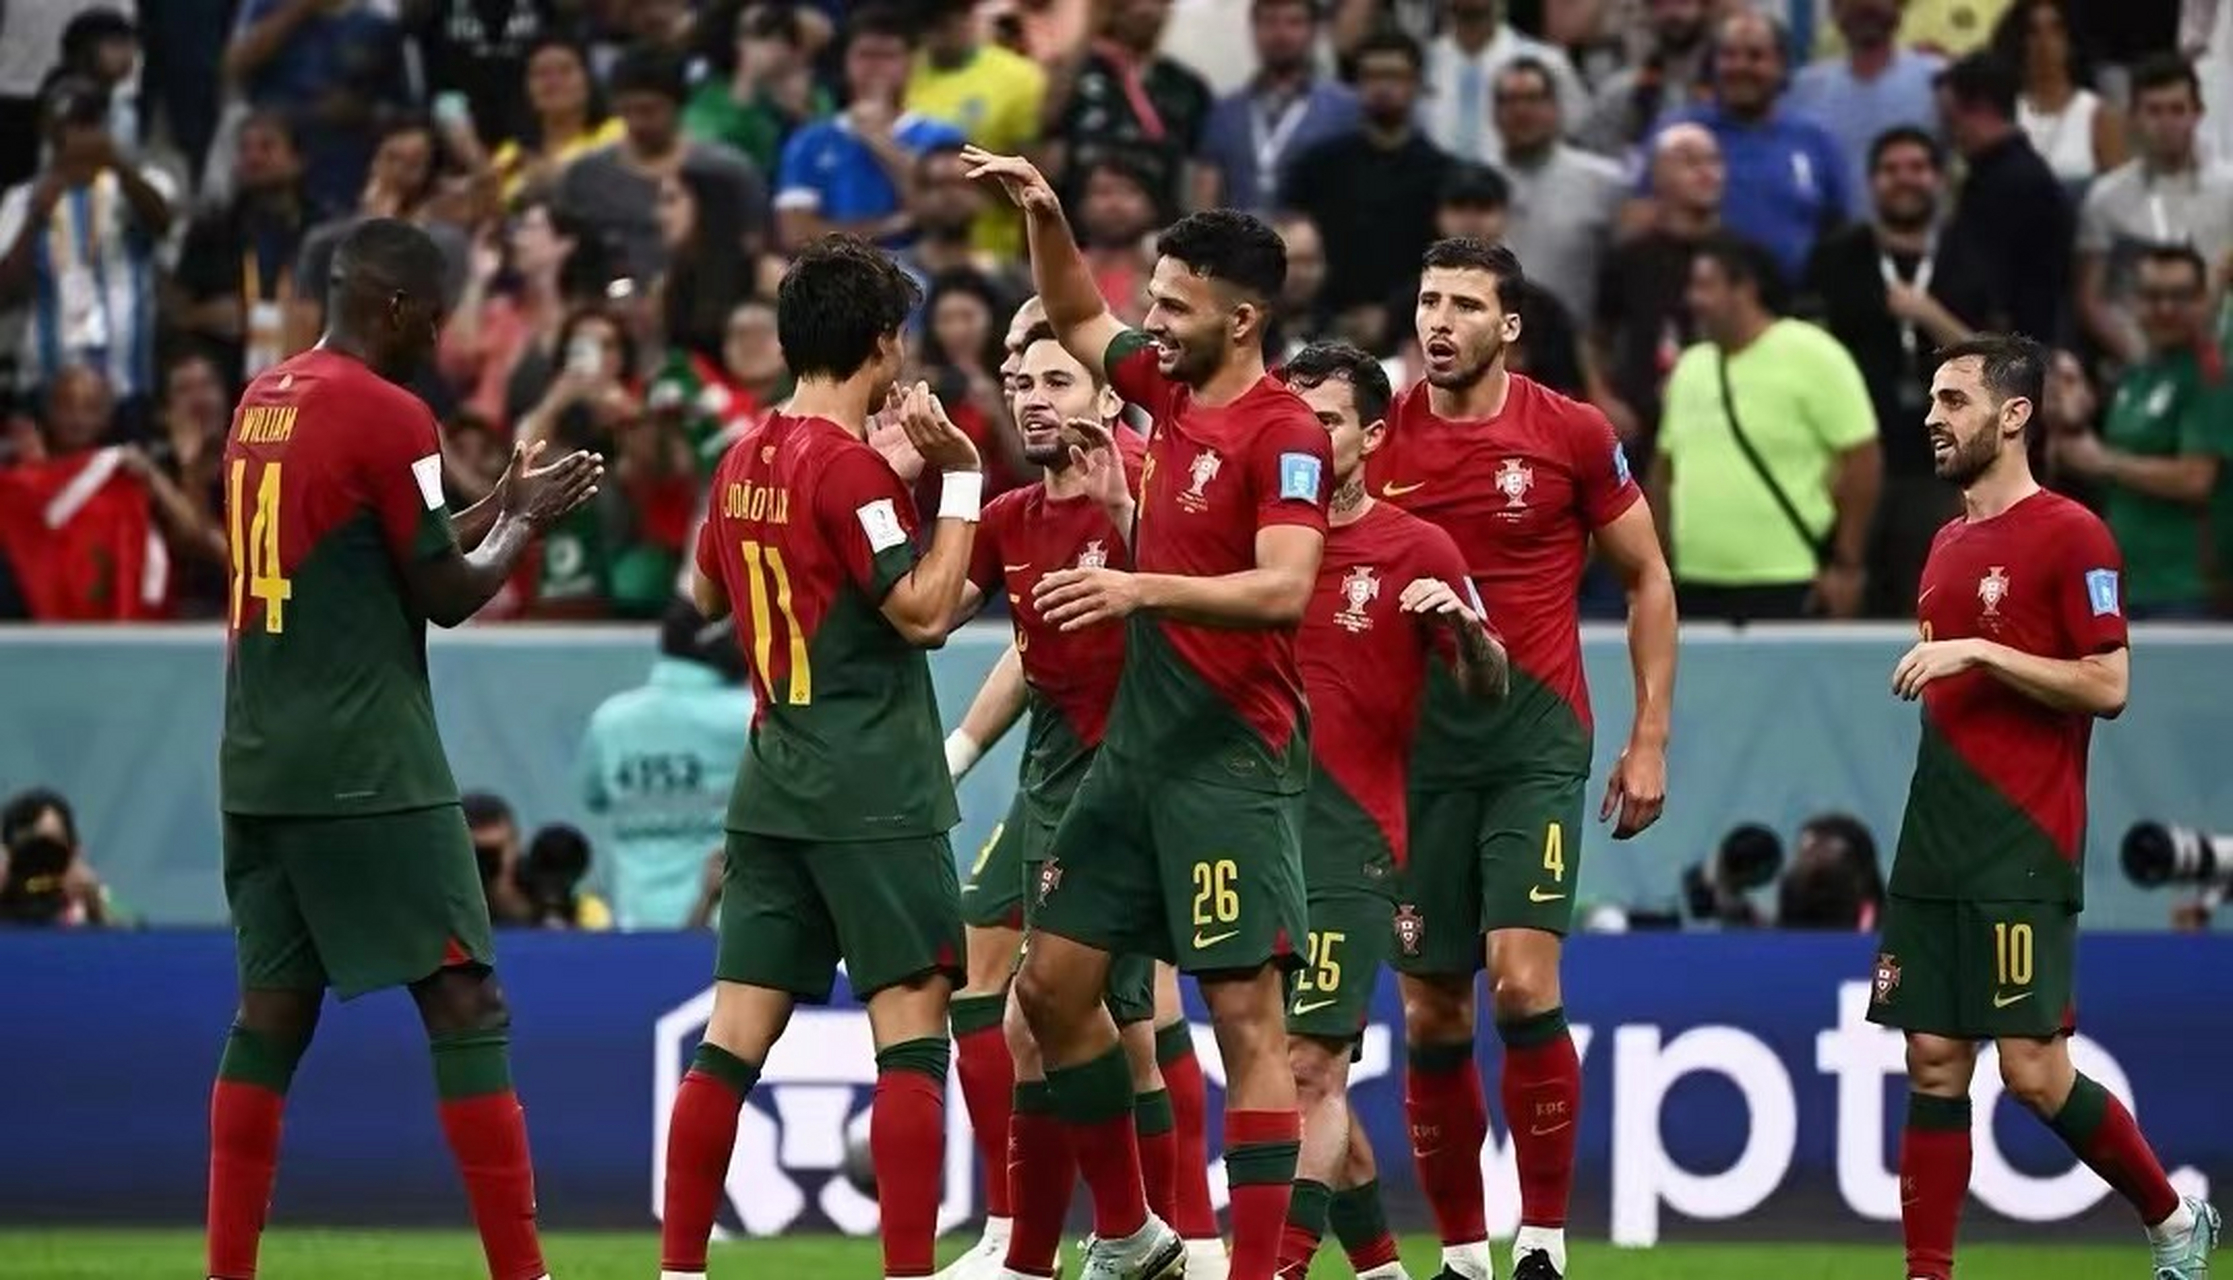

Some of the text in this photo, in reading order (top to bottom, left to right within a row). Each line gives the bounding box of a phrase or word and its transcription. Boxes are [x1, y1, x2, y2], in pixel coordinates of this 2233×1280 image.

[238, 406, 299, 443] WILLIAM
[231, 458, 292, 633] 14
[741, 541, 811, 705] 11
[1543, 822, 1565, 882] 4
[1193, 859, 1240, 925] 26
[1297, 931, 1345, 992] 25
[1995, 922, 2034, 985] 10
